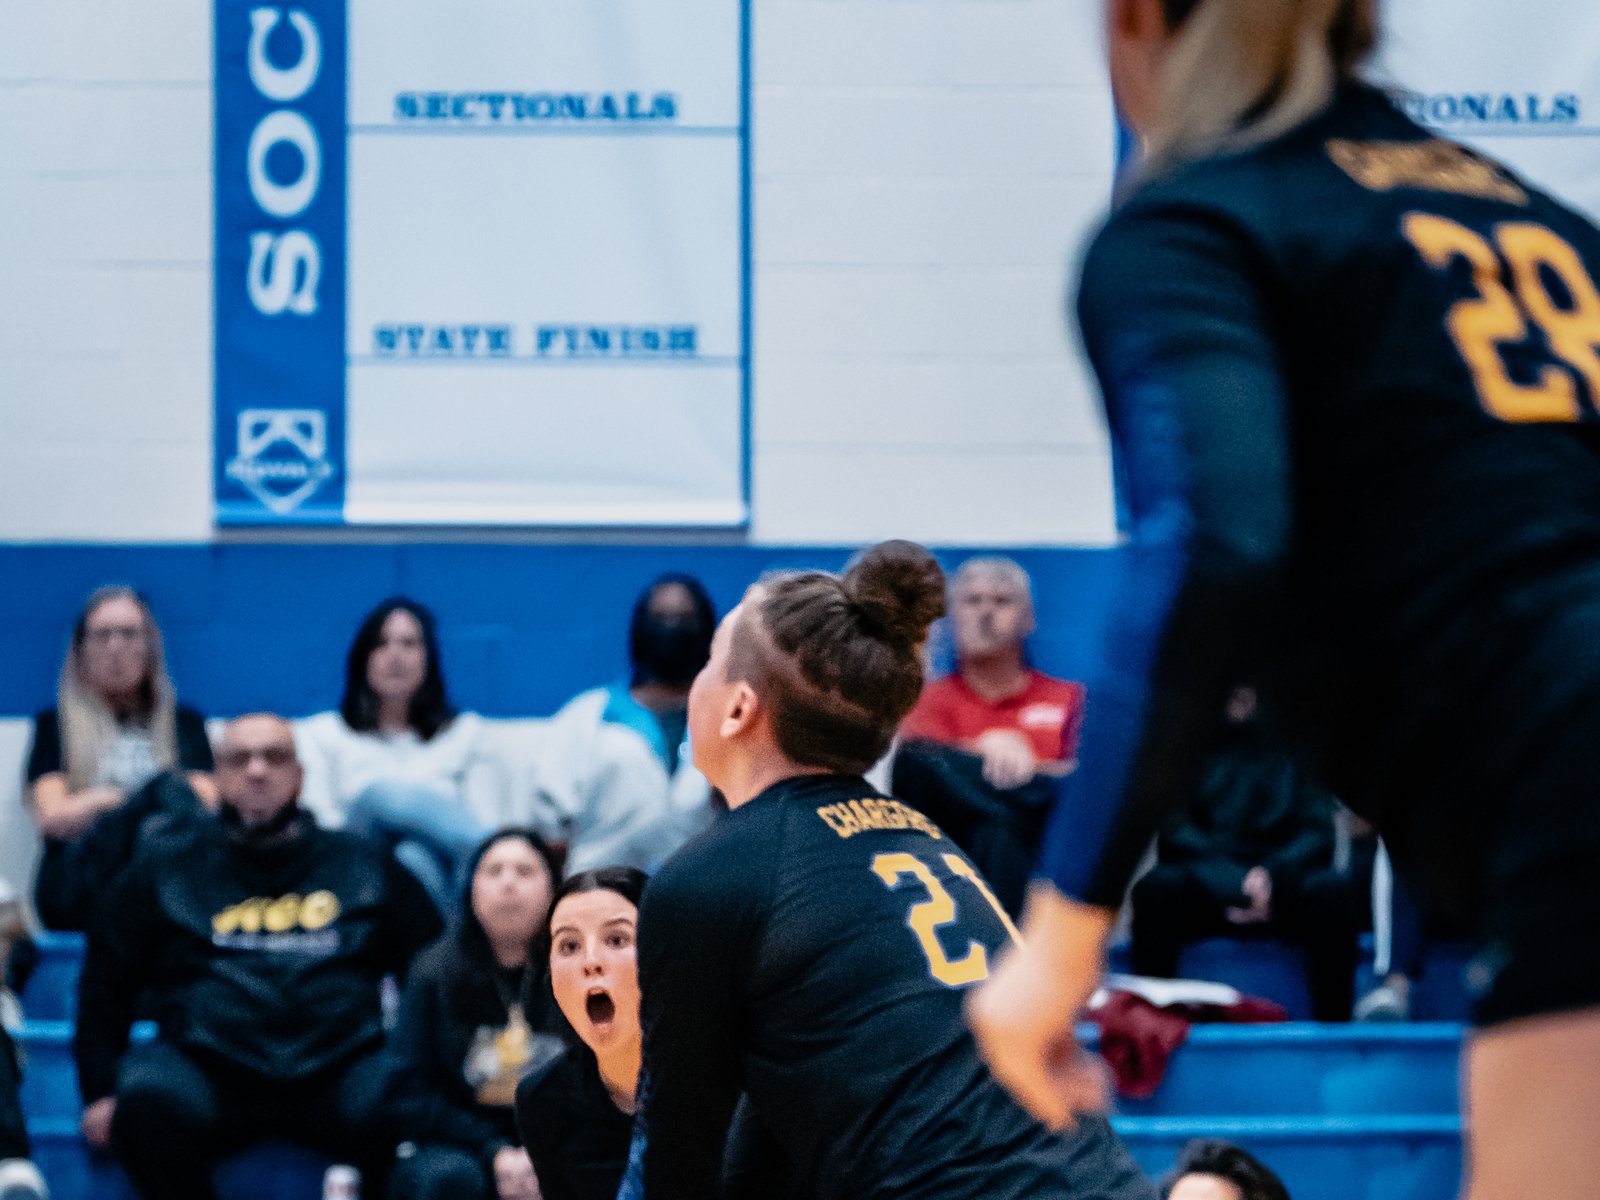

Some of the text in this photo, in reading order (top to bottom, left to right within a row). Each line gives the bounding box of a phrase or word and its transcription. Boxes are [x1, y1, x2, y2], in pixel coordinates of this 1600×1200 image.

[393, 91, 678, 121] SECTIONALS
[247, 8, 323, 316] SOC
[373, 323, 697, 356] STATE FINISH
